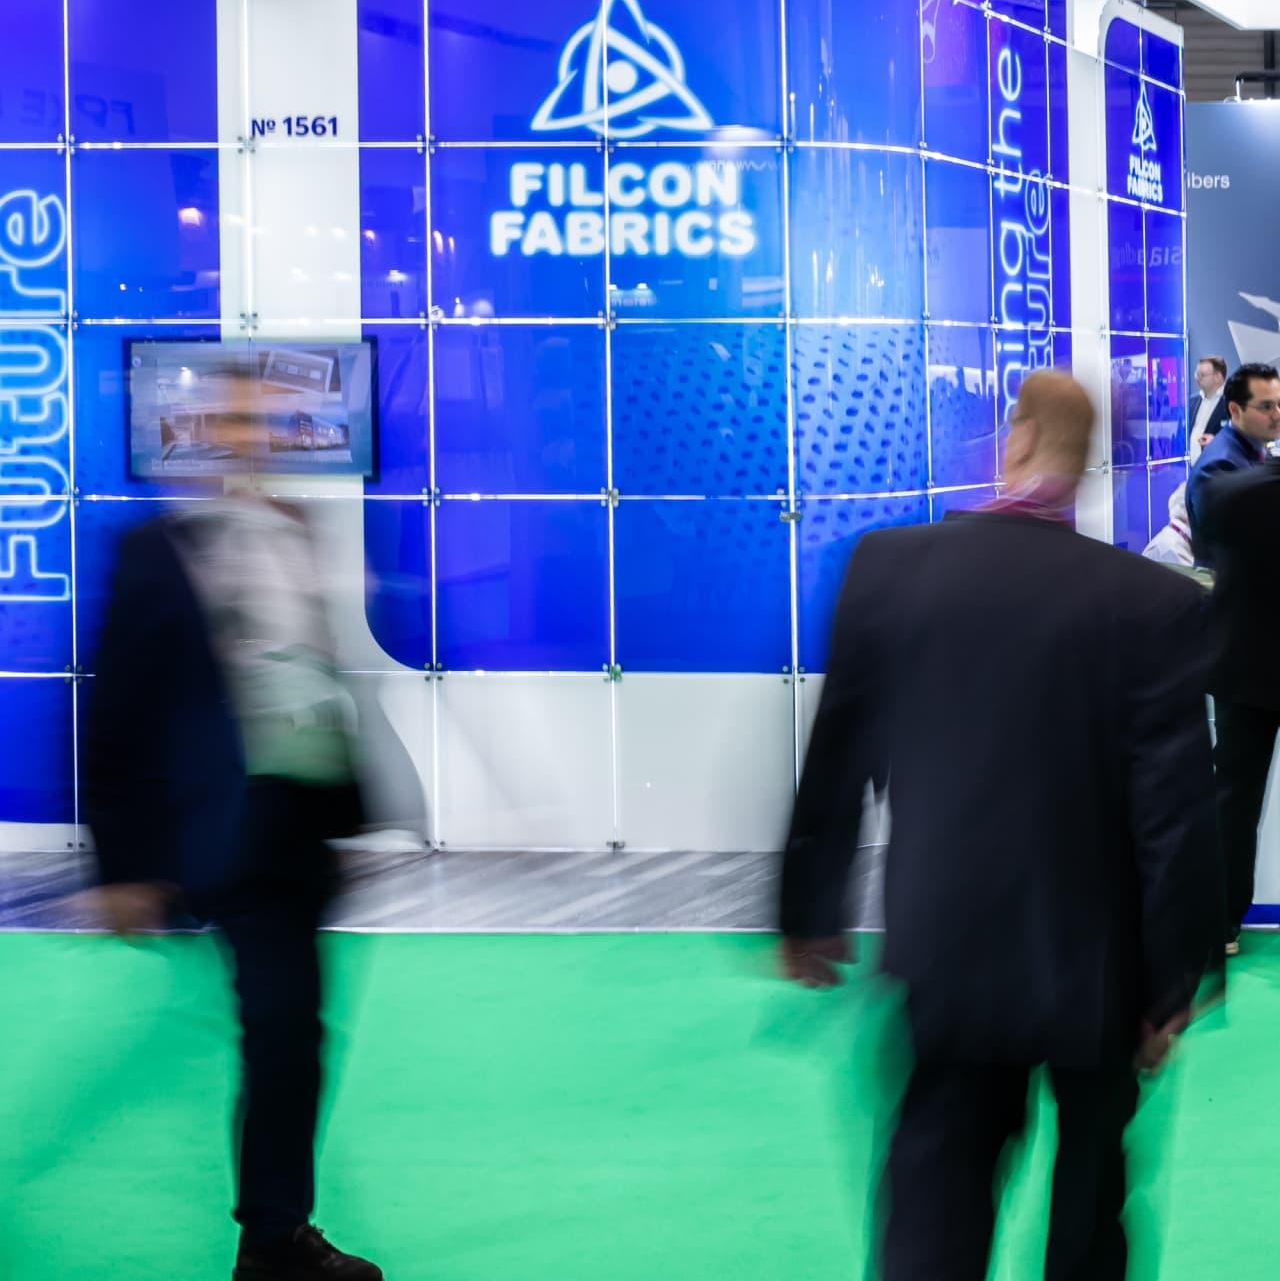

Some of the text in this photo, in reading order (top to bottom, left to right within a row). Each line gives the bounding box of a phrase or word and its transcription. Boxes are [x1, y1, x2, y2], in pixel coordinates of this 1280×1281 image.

[282, 116, 338, 136] 1561
[992, 47, 1023, 197] the
[510, 162, 739, 207] FILCON
[490, 210, 757, 256] FABRICS
